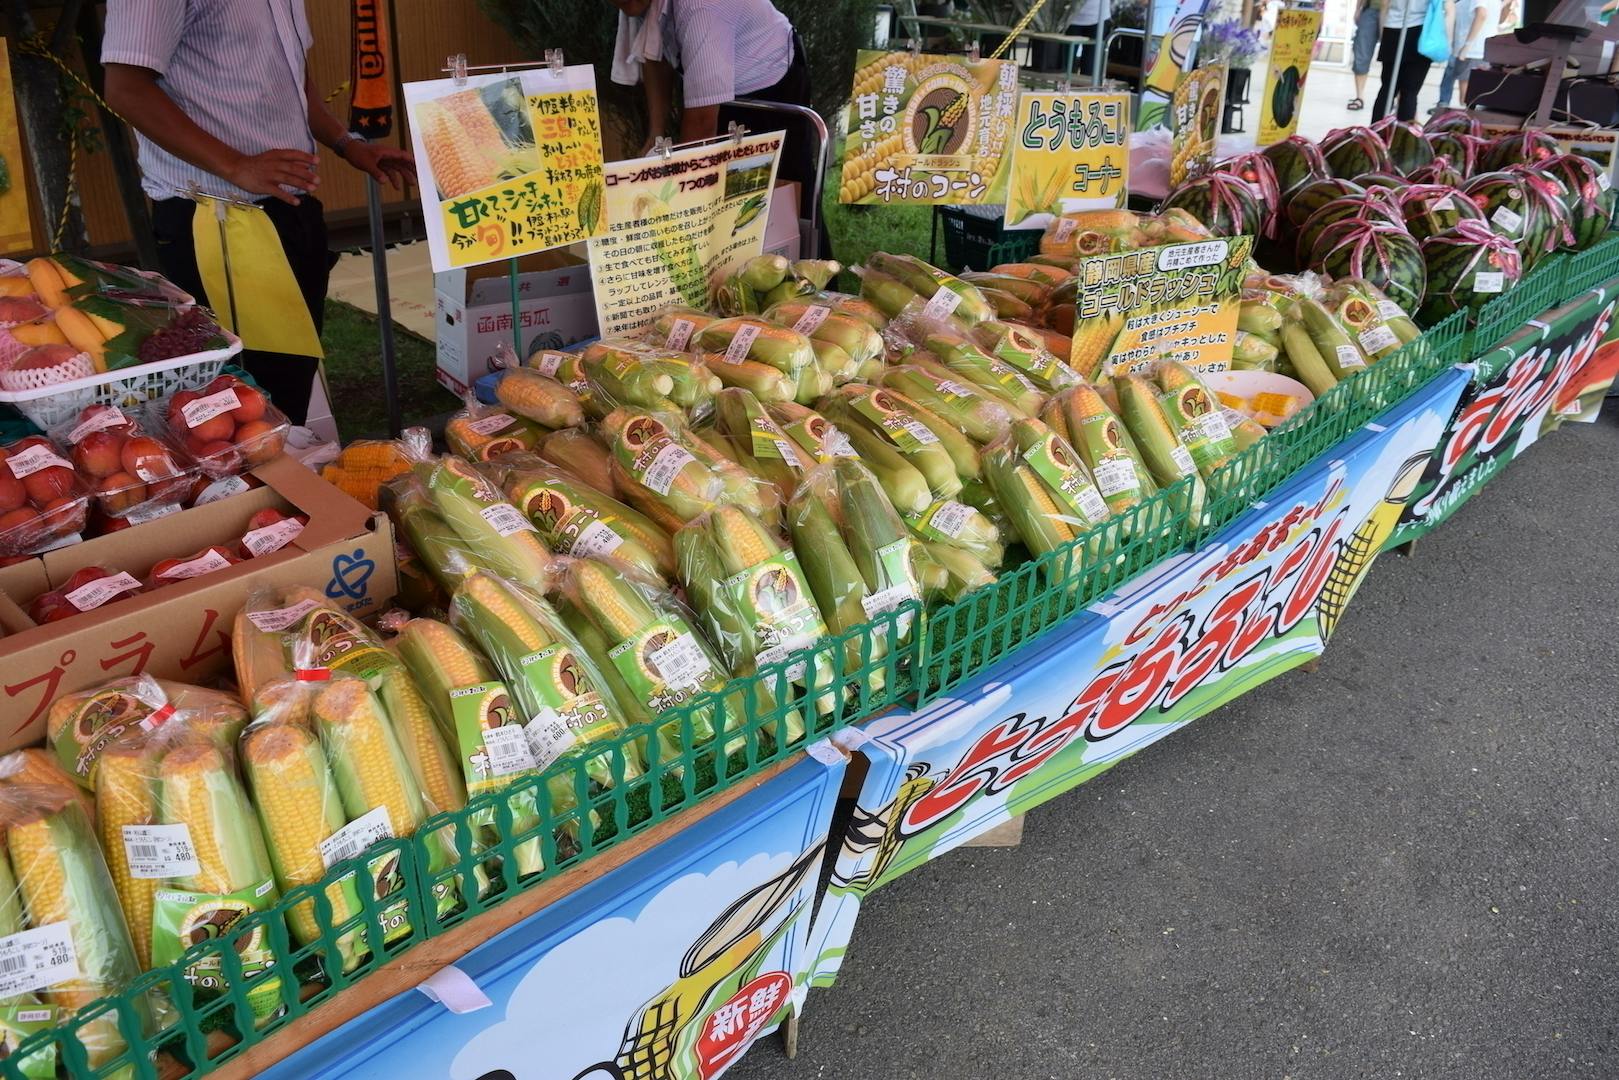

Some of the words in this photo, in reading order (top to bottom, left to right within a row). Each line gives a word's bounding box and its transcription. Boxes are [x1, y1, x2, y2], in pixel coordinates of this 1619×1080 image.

[1021, 100, 1126, 151] とうもろこし
[875, 166, 986, 202] 村のコーン
[1072, 156, 1121, 194] コーナー
[1083, 249, 1156, 288] 静岡県産
[1081, 272, 1217, 319] ゴールドラッシュ
[477, 307, 551, 334] 函南西瓜
[1126, 304, 1219, 331] 粒は大きくジューシーで
[1140, 321, 1198, 343] 食感はプチプチ
[4, 609, 232, 738] プラム
[903, 510, 1346, 836] とうもろこし
[175, 852, 191, 861] 480
[50, 953, 70, 966] 480
[709, 977, 785, 1043] 新鮮
